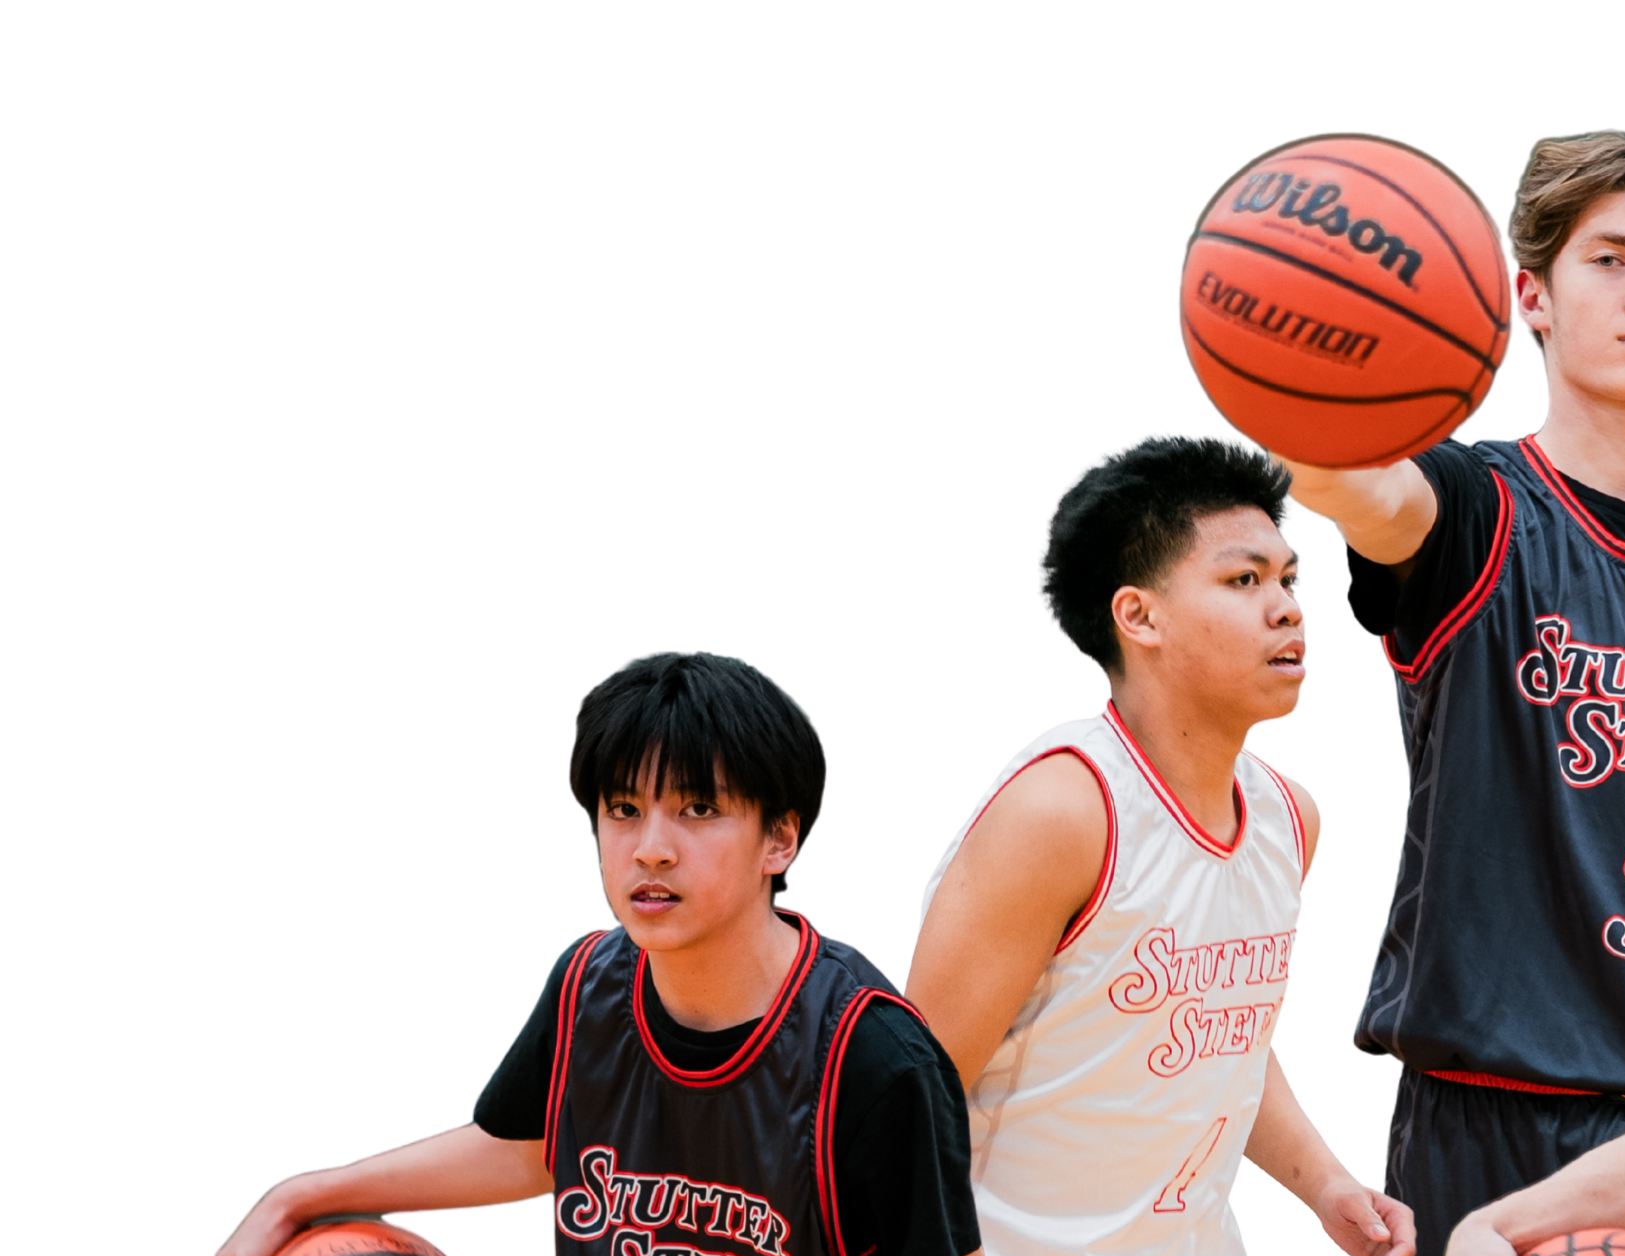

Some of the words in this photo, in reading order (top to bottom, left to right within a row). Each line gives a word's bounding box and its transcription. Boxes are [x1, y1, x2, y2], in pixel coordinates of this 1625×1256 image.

[1233, 172, 1423, 286] Wilson
[1198, 272, 1379, 361] EVOLUTION
[1108, 927, 1297, 1014] STUTTE
[1153, 1117, 1227, 1213] 1
